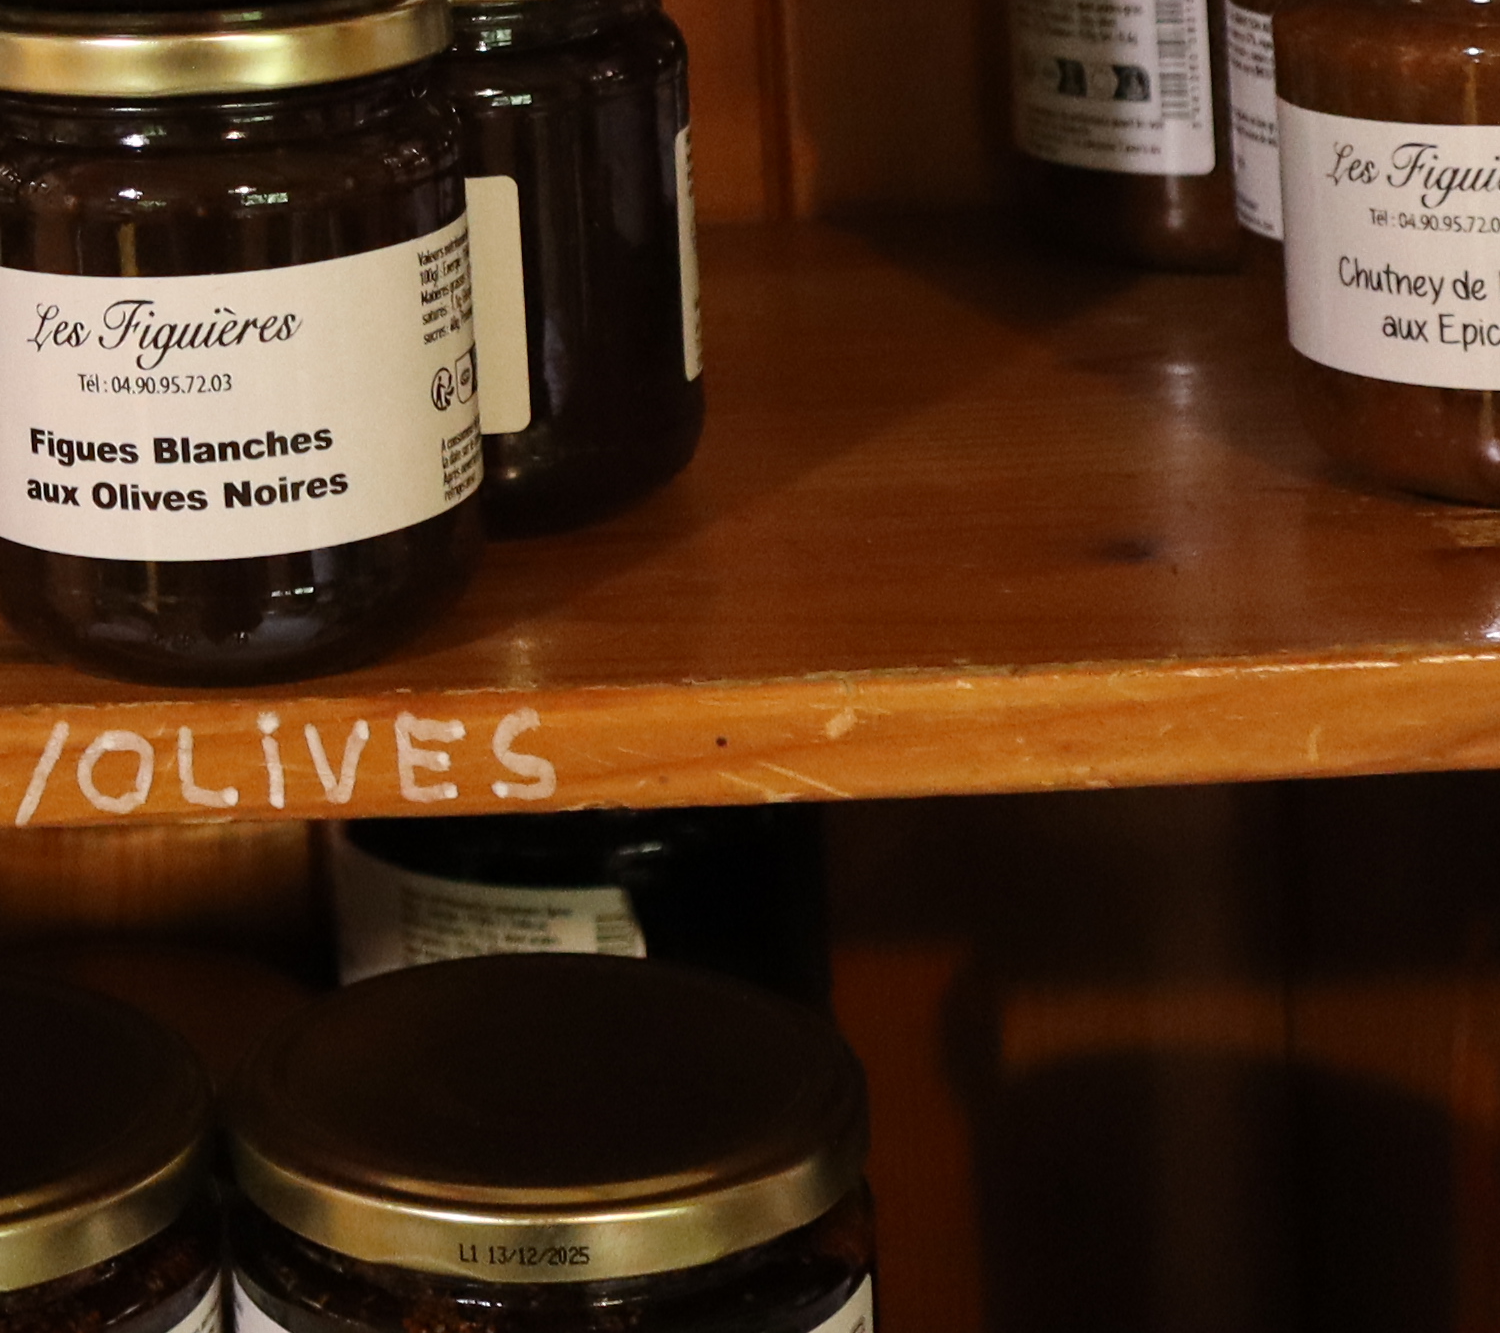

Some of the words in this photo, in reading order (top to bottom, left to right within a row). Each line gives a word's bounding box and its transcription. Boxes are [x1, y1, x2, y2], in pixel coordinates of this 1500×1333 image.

[27, 303, 91, 352] Les
[98, 299, 303, 370] Figuières
[30, 427, 139, 467] Figues
[153, 427, 334, 464] Blanches
[26, 476, 80, 507] aux
[92, 481, 209, 512] Olives
[223, 469, 350, 508] Noires
[458, 1244, 477, 1262] L1
[488, 1246, 590, 1265] 13/12/2025
